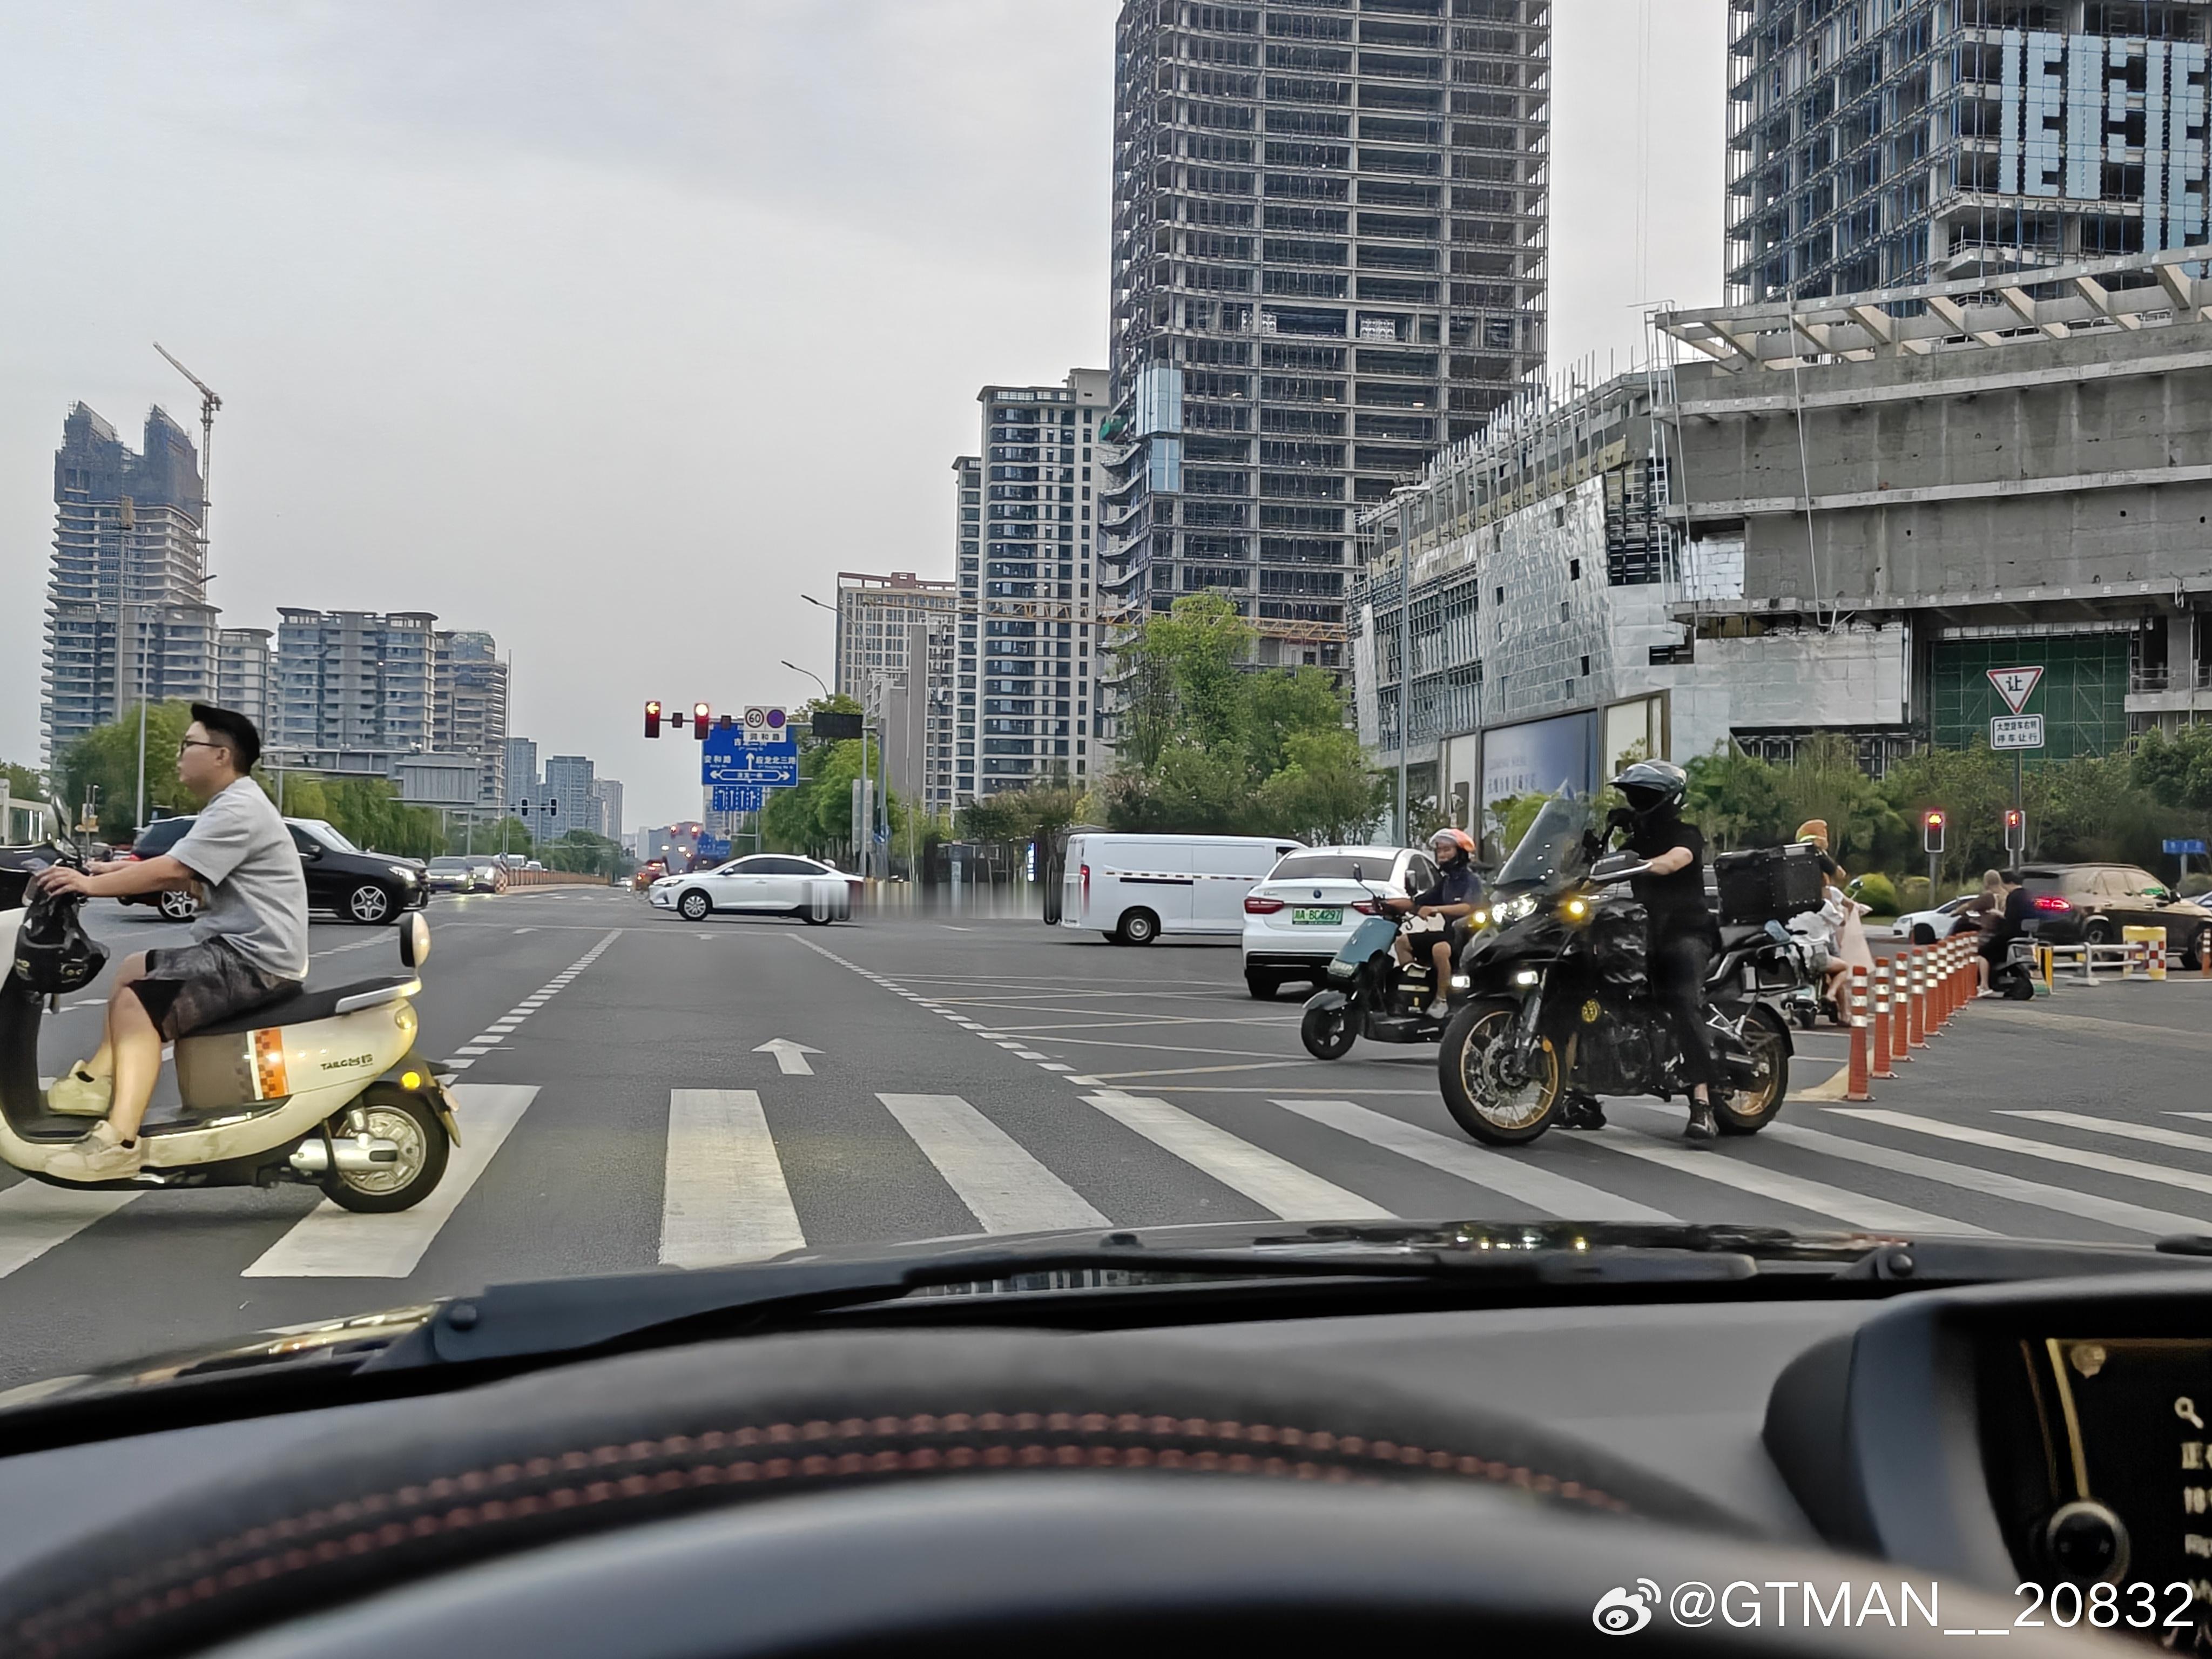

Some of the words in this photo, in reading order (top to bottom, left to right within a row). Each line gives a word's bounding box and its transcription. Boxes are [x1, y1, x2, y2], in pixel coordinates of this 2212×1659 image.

[2005, 675, 2024, 692] 让
[748, 713, 761, 723] 60
[1997, 732, 2038, 744] 停车让行
